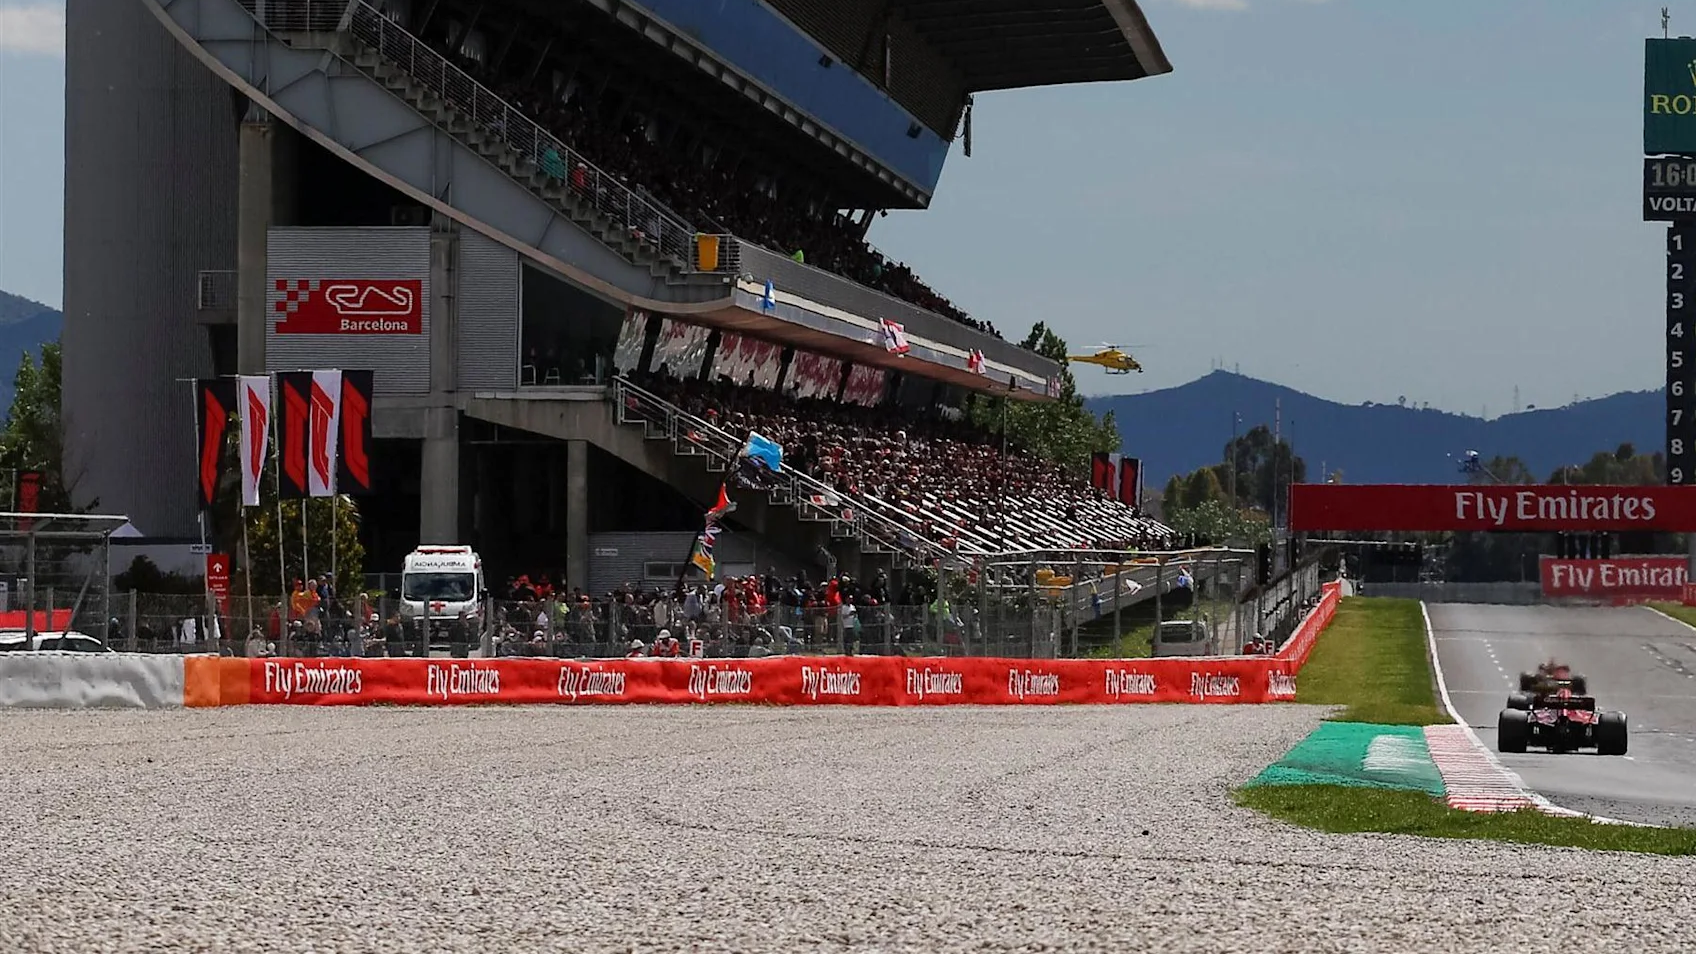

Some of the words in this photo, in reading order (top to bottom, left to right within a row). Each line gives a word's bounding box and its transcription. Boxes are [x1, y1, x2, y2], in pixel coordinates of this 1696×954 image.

[1673, 235, 1682, 250] 1
[1671, 263, 1684, 279] 2
[1672, 293, 1684, 309] 3
[340, 318, 408, 331] Barcelona
[1671, 322, 1684, 337] 4
[1671, 351, 1683, 367] 5
[1671, 381, 1683, 396] 6
[1671, 410, 1683, 425] 7
[1671, 439, 1683, 454] 8
[1671, 468, 1683, 483] 9
[1455, 492, 1508, 525] Fly
[1517, 490, 1656, 521] Emirates
[1552, 564, 1593, 592] Fly
[692, 642, 701, 655] F
[1265, 642, 1272, 654] F
[265, 662, 292, 699] Fly
[295, 662, 361, 694] Emirates
[427, 664, 448, 700] Fly
[450, 663, 499, 694] Emirates
[558, 666, 577, 699] Fly
[579, 665, 626, 696] Emirates
[688, 664, 705, 699] Fly
[707, 664, 752, 694] Emirates
[802, 666, 818, 700] Fly
[819, 666, 860, 695] Emirates
[907, 668, 923, 700] Fly
[924, 667, 962, 694] Emirates
[1009, 669, 1024, 699] Fly
[1025, 669, 1059, 695] Emirates
[1105, 669, 1119, 699] Fly
[1121, 668, 1155, 694] Emirates
